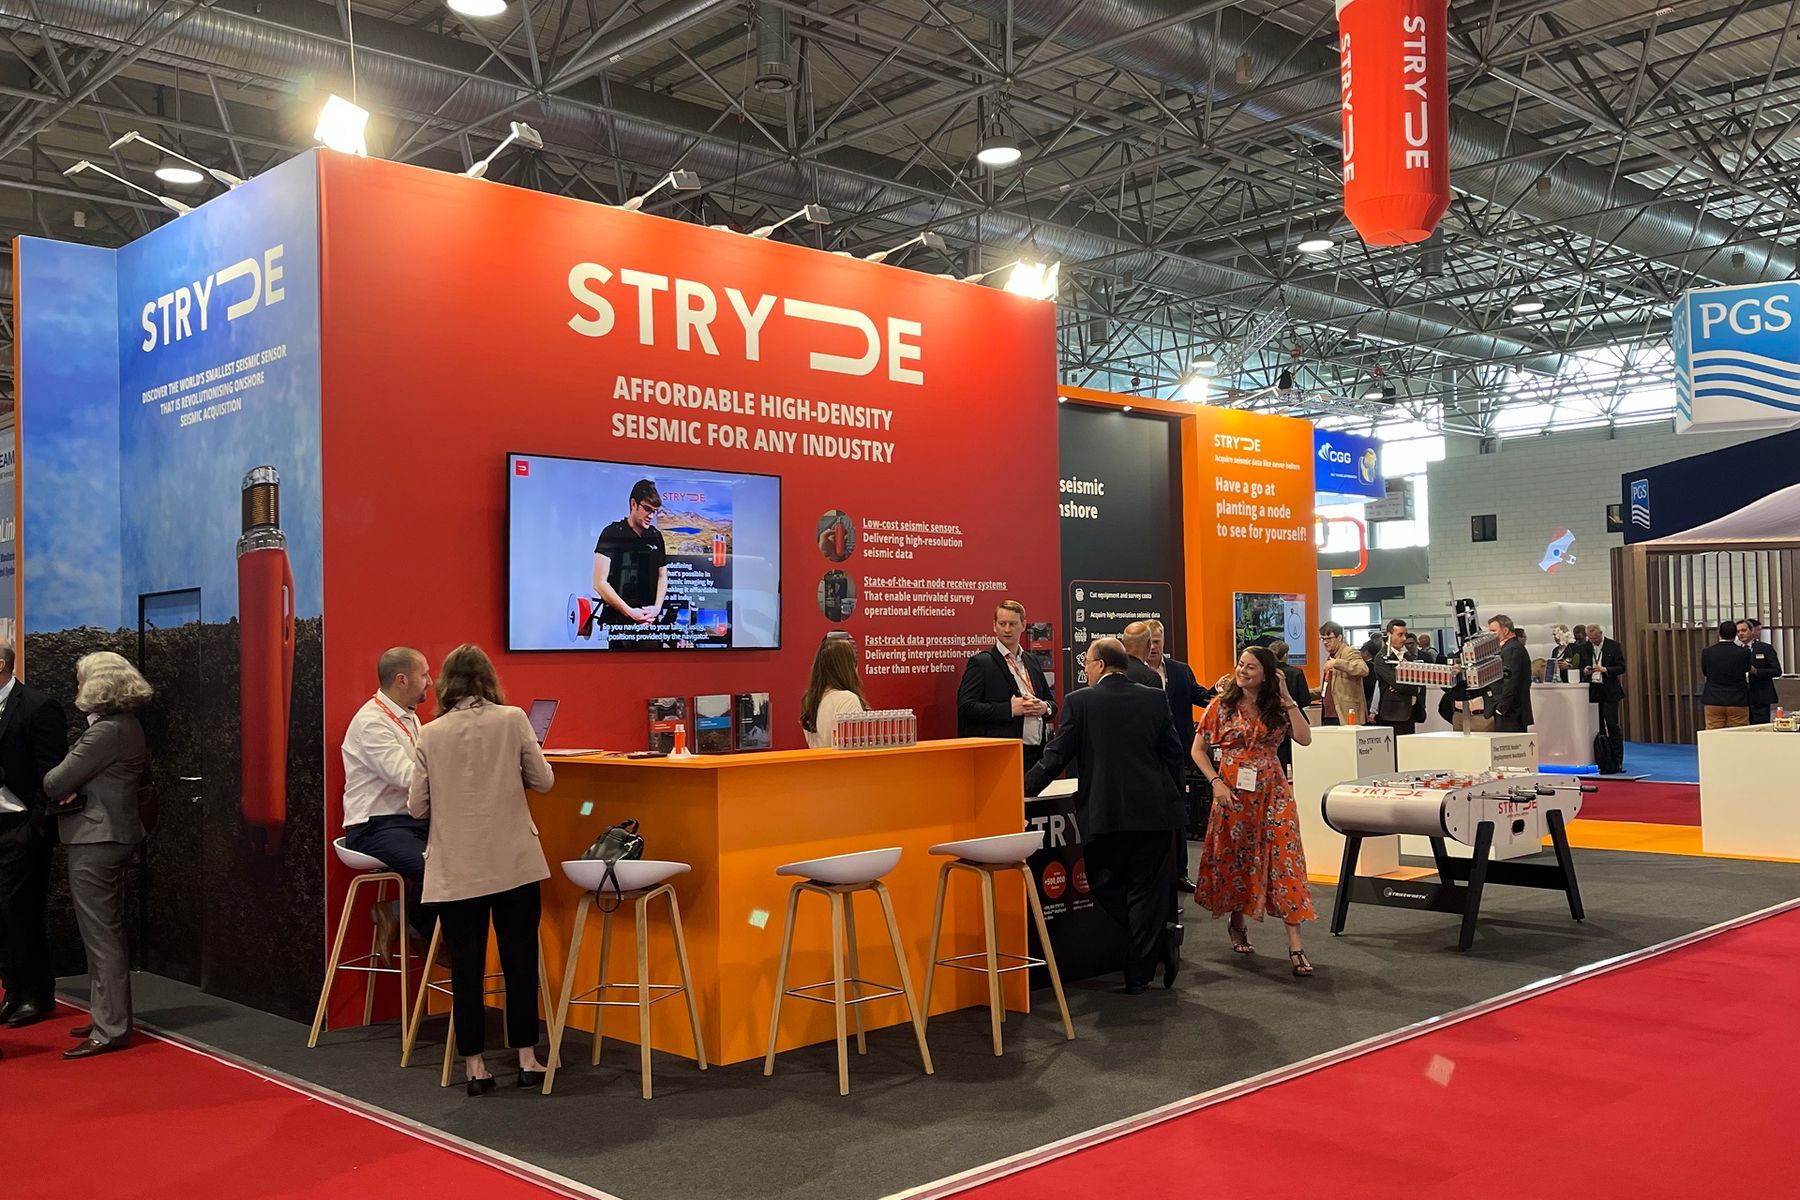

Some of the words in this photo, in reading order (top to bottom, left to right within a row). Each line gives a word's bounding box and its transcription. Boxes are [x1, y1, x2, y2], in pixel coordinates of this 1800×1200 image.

[1403, 15, 1429, 169] STRYDE
[1341, 32, 1355, 185] STRYDE
[142, 244, 285, 352] STRYDE
[567, 262, 924, 386] STRYDE
[1699, 295, 1792, 338] PGS
[142, 385, 168, 404] DISCOVER
[168, 381, 179, 395] THE
[179, 371, 205, 391] WORLD'S
[205, 362, 235, 382] SMALLEST
[235, 353, 261, 373] SEISMIC
[261, 344, 287, 364] SENSOR
[160, 401, 175, 415] THAT
[175, 399, 181, 410] IS
[181, 382, 234, 409] REVOLUTIONISING
[234, 371, 265, 391] ONSHORE
[612, 375, 755, 416] AFFORDABLE
[760, 394, 894, 431] HIGH-DENSITY
[180, 410, 202, 427] SEISMIC
[202, 397, 242, 420] ACQUISITION
[611, 412, 702, 445] SEISMIC
[707, 423, 749, 451] FOR
[753, 429, 797, 455] ANY
[802, 432, 895, 463] INDUSTRY
[1214, 434, 1261, 452] STRYDE
[1215, 454, 1233, 464] Acquire
[1233, 457, 1251, 465] seismic
[1252, 458, 1262, 466] data
[1263, 459, 1272, 467] like
[1272, 461, 1286, 469] never
[1285, 462, 1300, 470] before
[1330, 450, 1351, 464] CGG
[1059, 476, 1105, 496] seismic
[1215, 477, 1242, 493] Have
[1242, 482, 1250, 494] a
[1251, 483, 1263, 498] go
[1265, 482, 1276, 496] at
[1633, 483, 1648, 499] PGS
[662, 491, 705, 502] STRYDE
[1059, 500, 1098, 519] nshore
[1216, 499, 1257, 520] planting
[1259, 505, 1266, 517] a
[1267, 503, 1291, 519] node
[863, 517, 899, 530] Low-cost
[900, 521, 930, 532] seismic
[863, 532, 904, 547] Delivering
[905, 534, 963, 548] high-resolution
[1217, 524, 1228, 537] to
[1230, 525, 1247, 539] see
[1249, 524, 1263, 539] for
[1265, 527, 1307, 544] yourself!
[863, 548, 893, 559] seismic
[895, 549, 913, 559] data
[682, 570, 704, 578] possible
[684, 578, 706, 586] imaging
[706, 578, 714, 586] by
[667, 586, 684, 594] aking
[690, 586, 718, 594] affordable
[863, 576, 925, 588] State-of-the-art
[927, 579, 945, 588] node
[947, 580, 977, 589] receiver
[978, 580, 1007, 591] systems
[864, 591, 882, 601] That
[884, 591, 911, 602] enable
[912, 592, 949, 603] unrivaled
[950, 594, 974, 605] survey
[864, 606, 911, 618] operational
[912, 605, 955, 617] efficiencies
[1106, 611, 1136, 619] high-resolution
[623, 623, 649, 632] navigate
[657, 624, 670, 632] your
[608, 633, 635, 641] positions
[636, 633, 662, 641] provided
[663, 633, 671, 641] by
[671, 632, 681, 640] the
[865, 634, 906, 645] Fast-track
[907, 634, 925, 645] data
[926, 634, 966, 648] processing
[865, 649, 907, 662] Delivering
[865, 663, 891, 675] faster
[892, 663, 910, 674] than
[911, 664, 930, 674] ever
[930, 662, 955, 673] before
[1352, 787, 1425, 797] STRYDE
[1498, 801, 1537, 814] STRYDE
